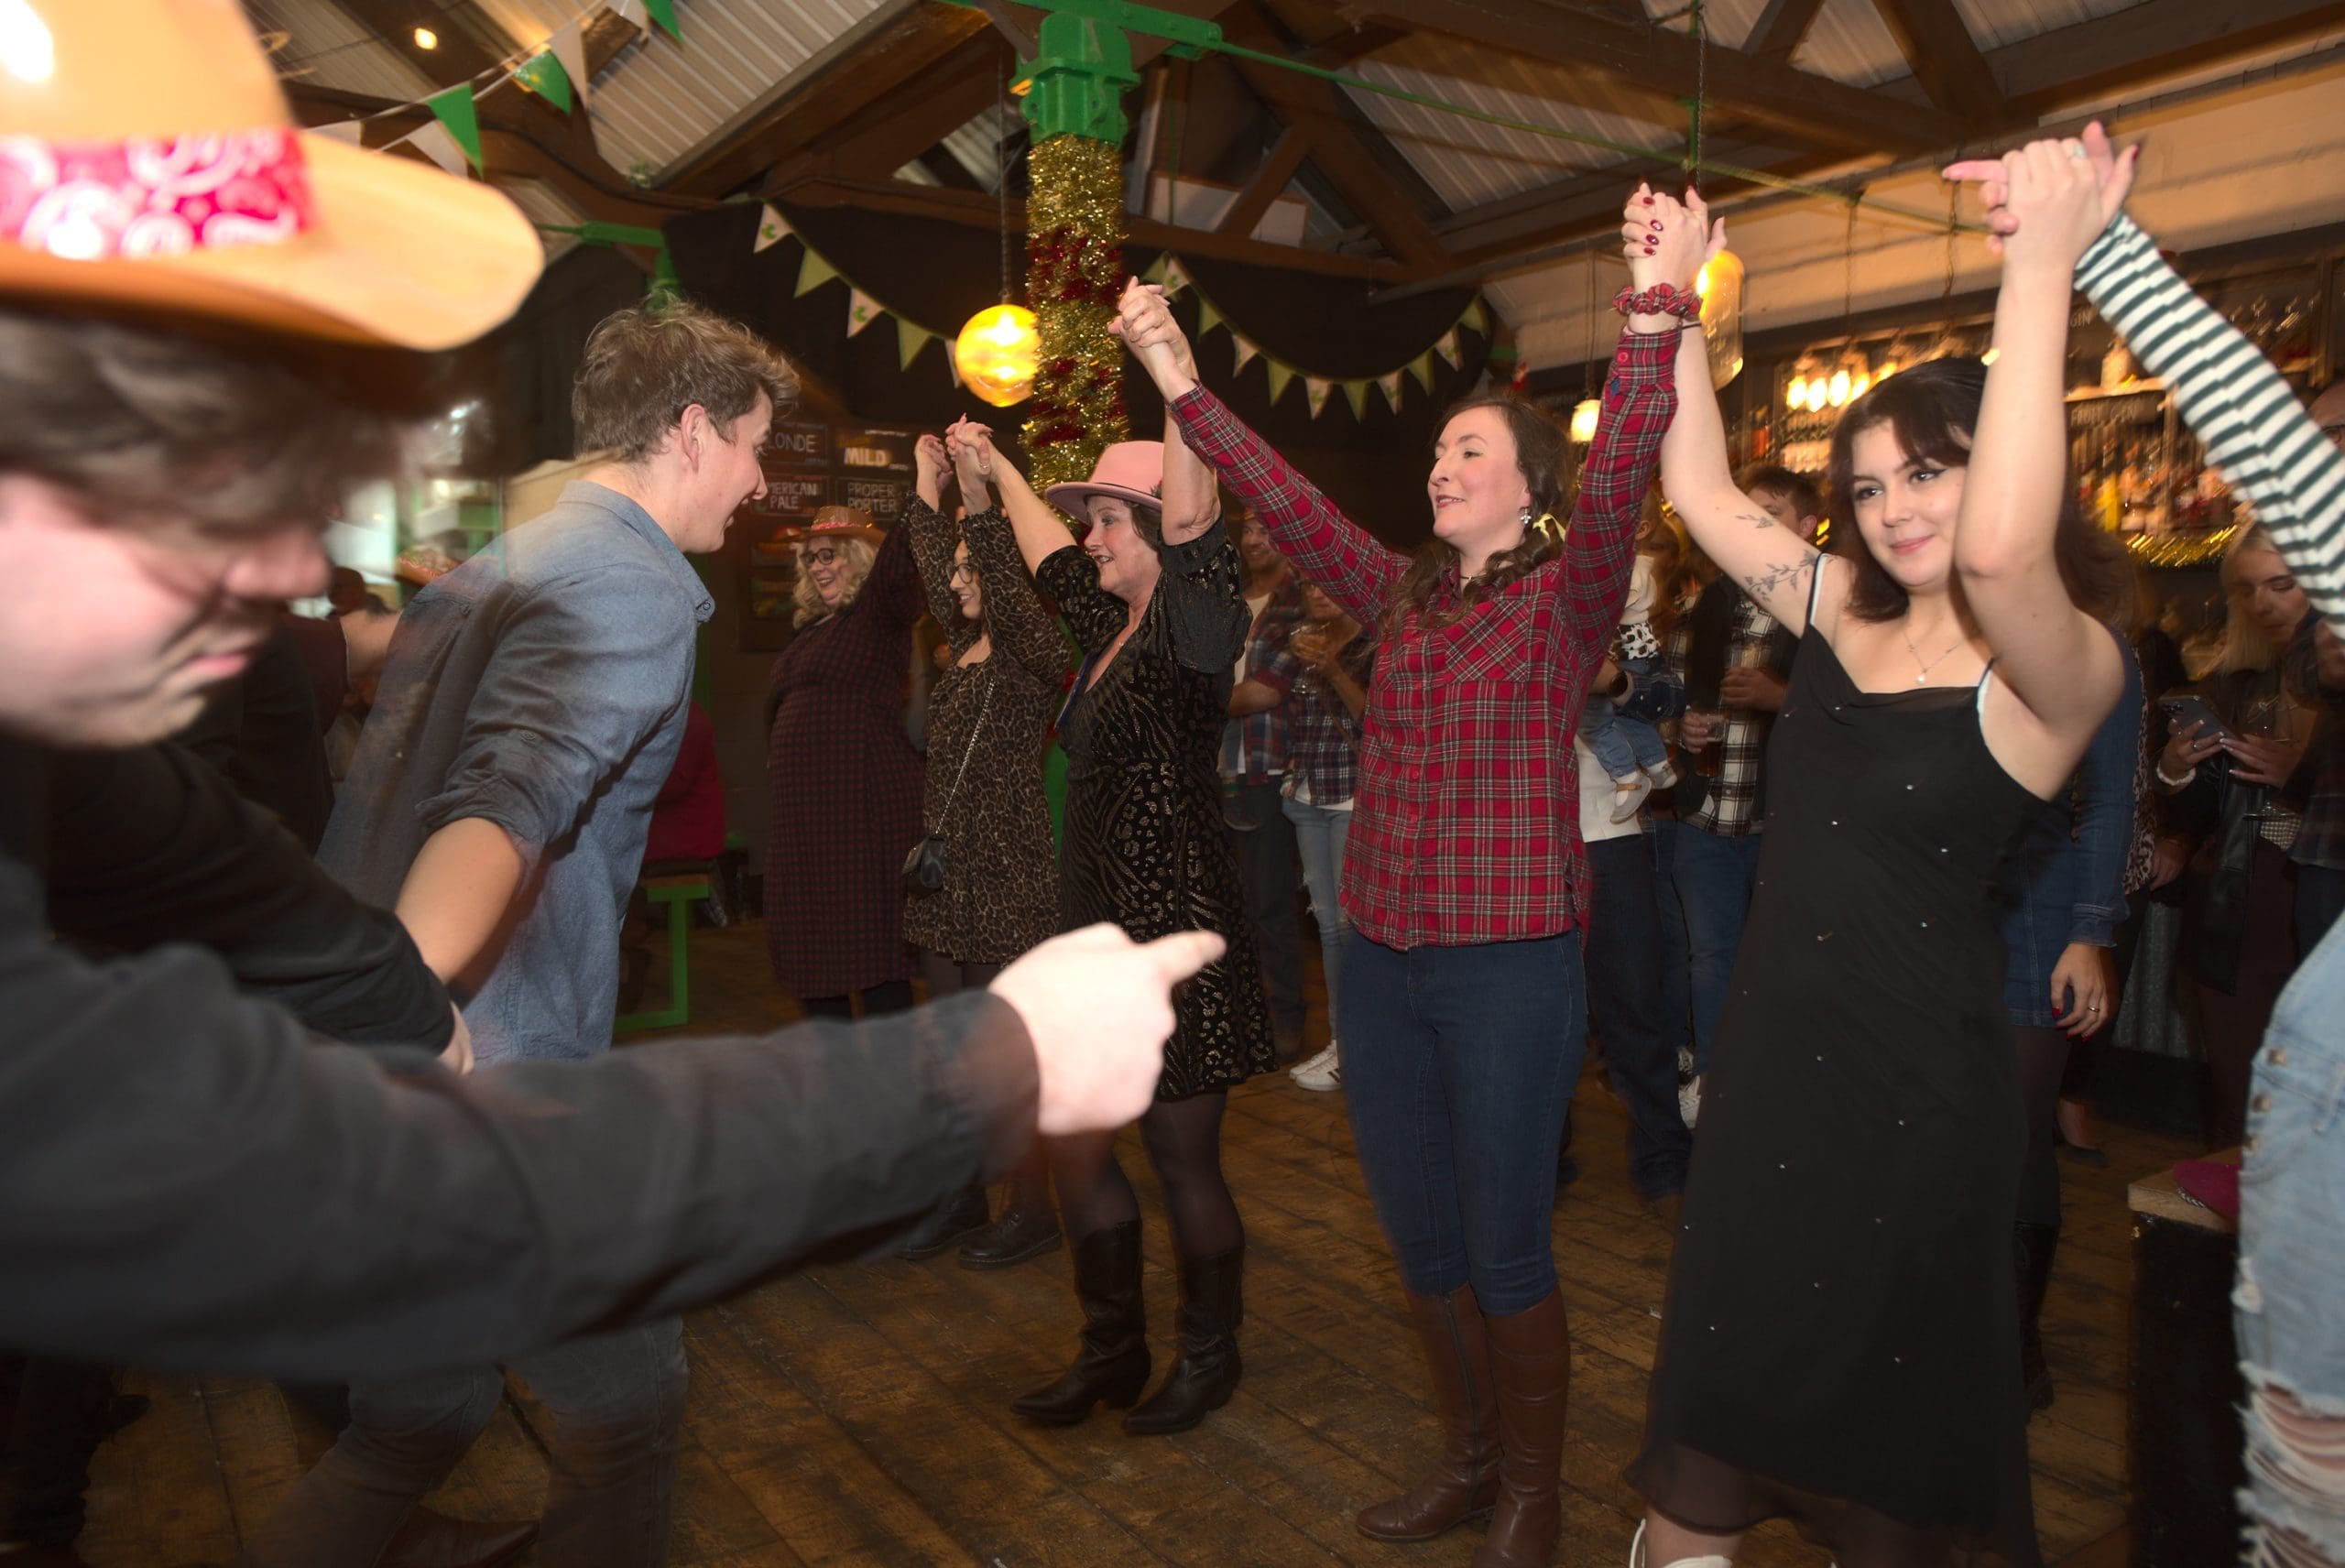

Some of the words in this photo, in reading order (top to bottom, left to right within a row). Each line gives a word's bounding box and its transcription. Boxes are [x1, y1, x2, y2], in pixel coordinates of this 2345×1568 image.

[767, 432, 817, 452] LONDE
[844, 447, 888, 466] MILD
[767, 482, 817, 495] MERICAN
[847, 483, 895, 497] PROPER
[769, 496, 799, 509] PALE
[847, 498, 898, 512] PORTER
